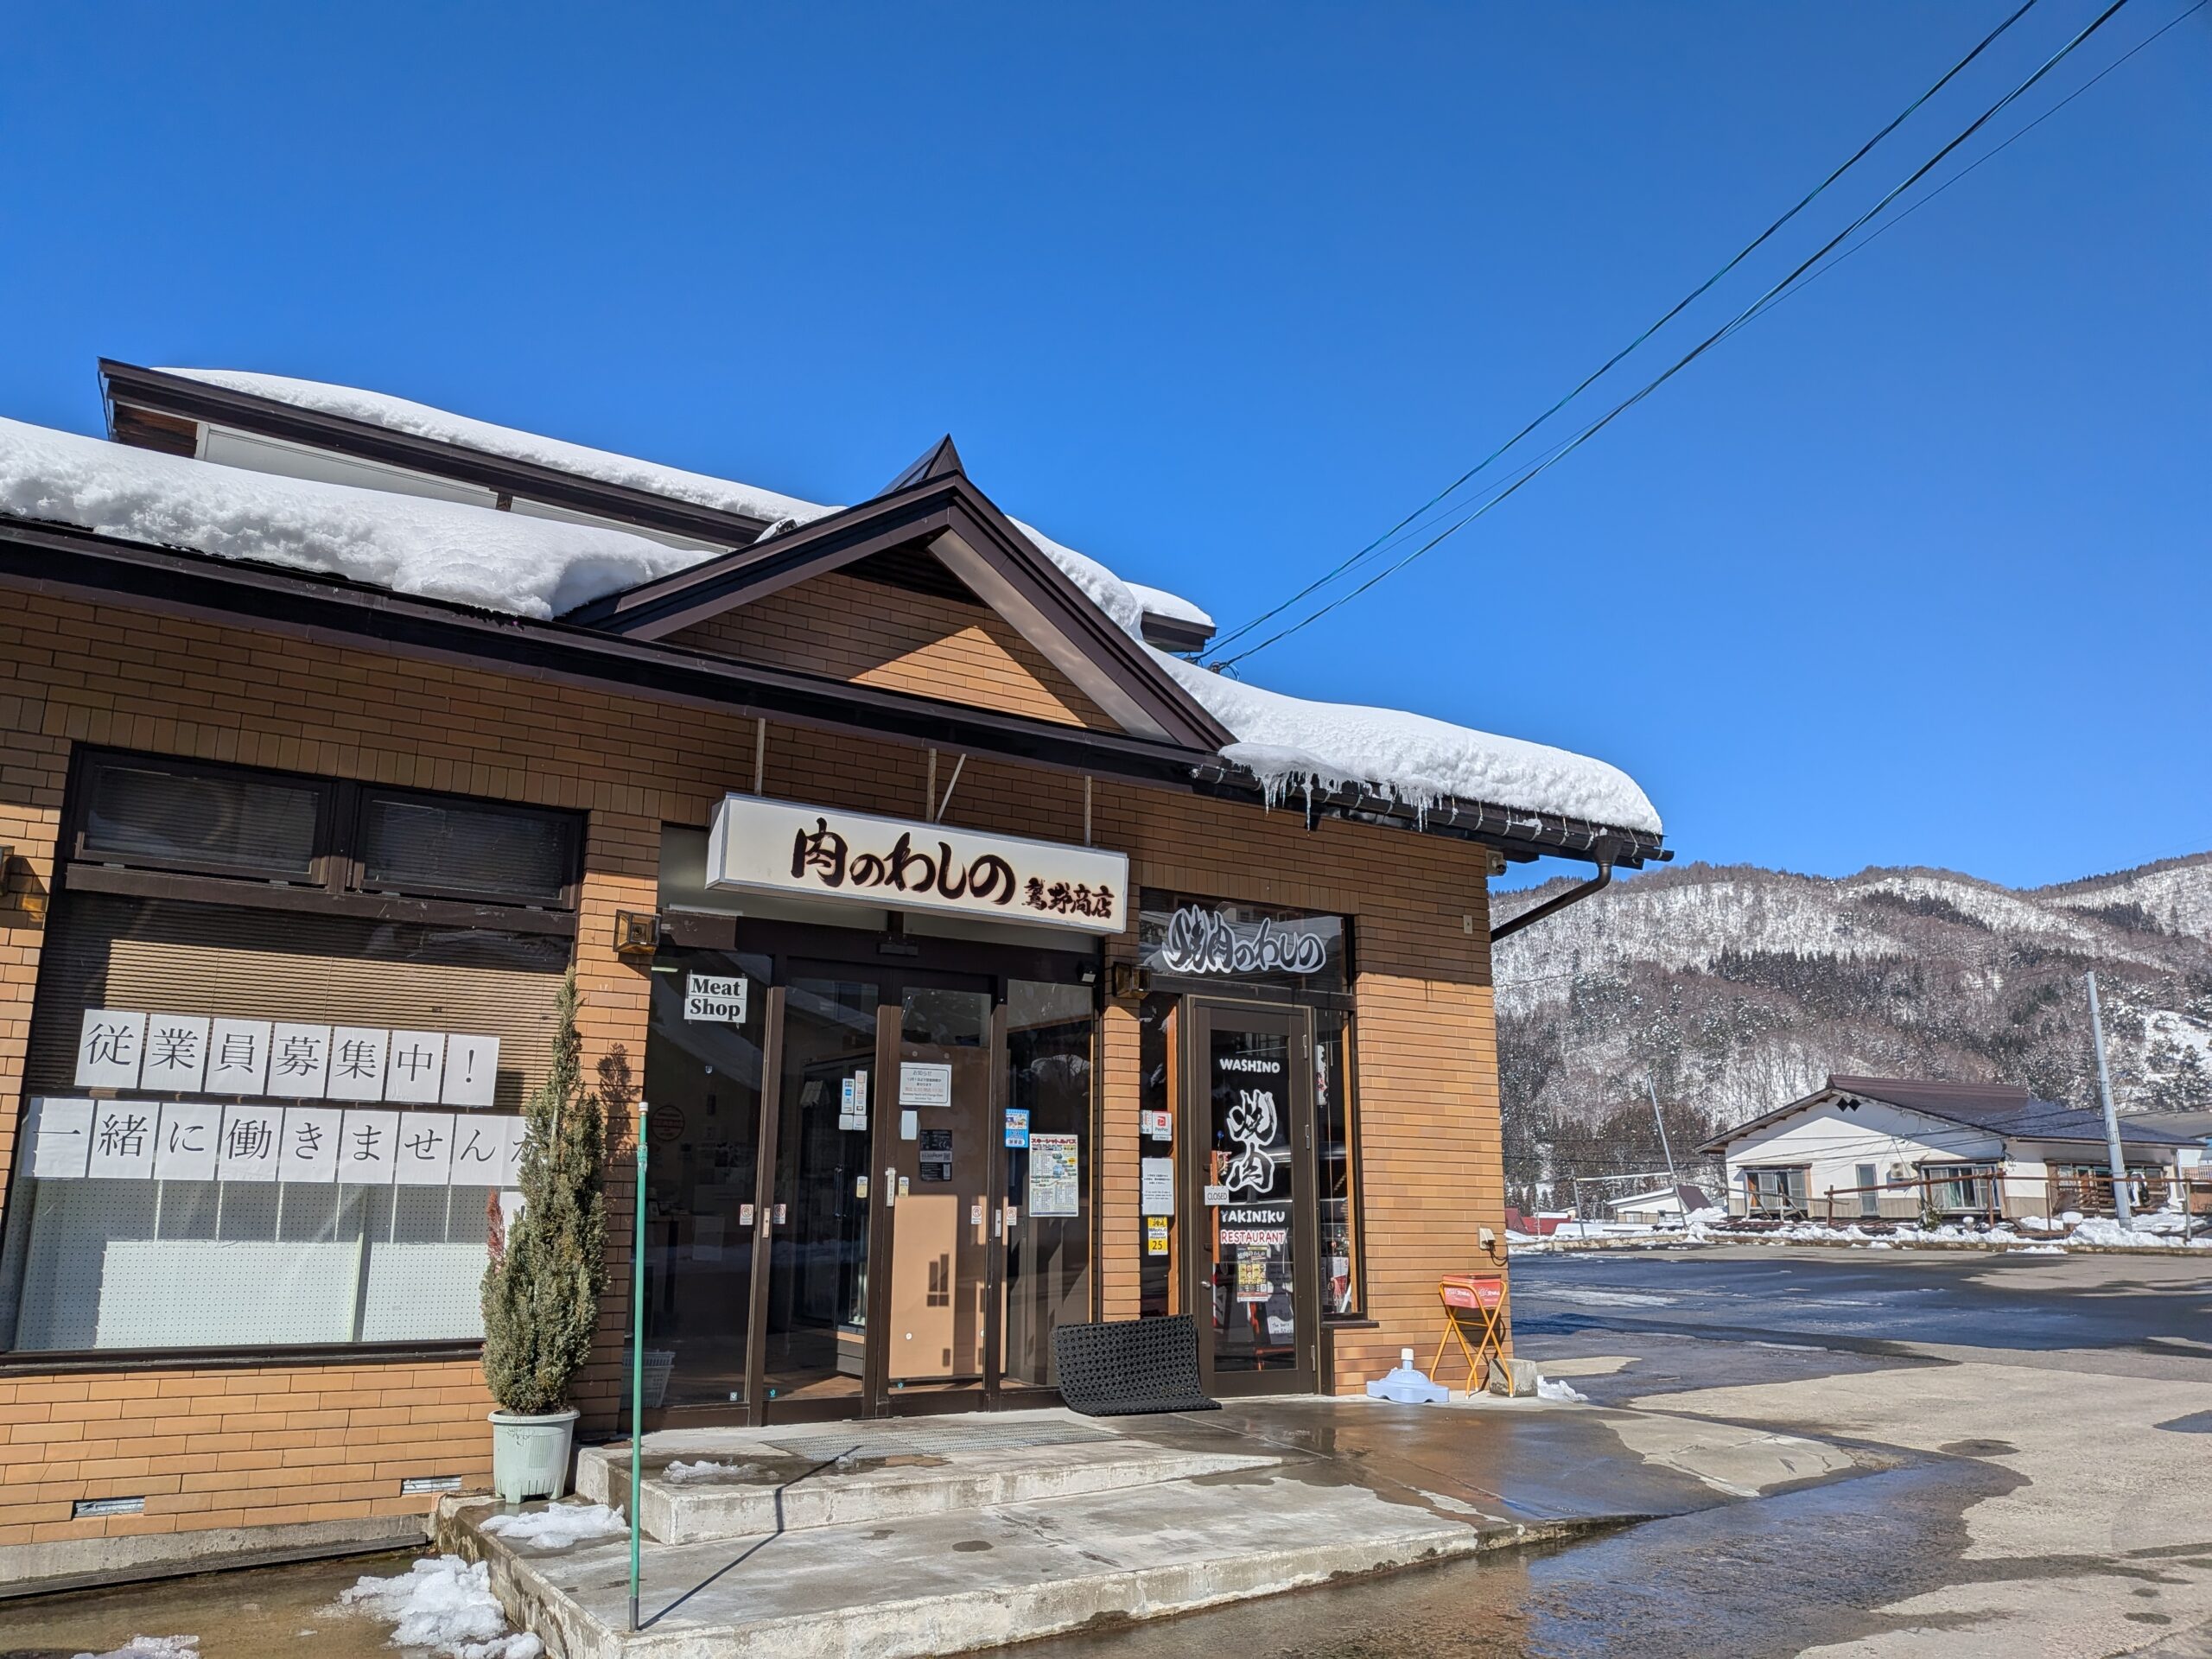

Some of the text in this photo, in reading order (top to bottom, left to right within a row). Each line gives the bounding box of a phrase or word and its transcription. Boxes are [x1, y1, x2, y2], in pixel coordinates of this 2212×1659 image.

[791, 817, 1016, 906] 肉のわしの
[690, 977, 741, 998] Meat
[690, 998, 741, 1022] Shop
[84, 1021, 475, 1084] 従業員募集中！
[1219, 1058, 1281, 1073] WASHINO
[1226, 1089, 1277, 1193] 焼肉
[1207, 1192, 1228, 1201] CLOSED
[1220, 1210, 1286, 1224] YAKINIKU
[1152, 1240, 1163, 1250] 25
[1220, 1230, 1286, 1245] RESTAURANT
